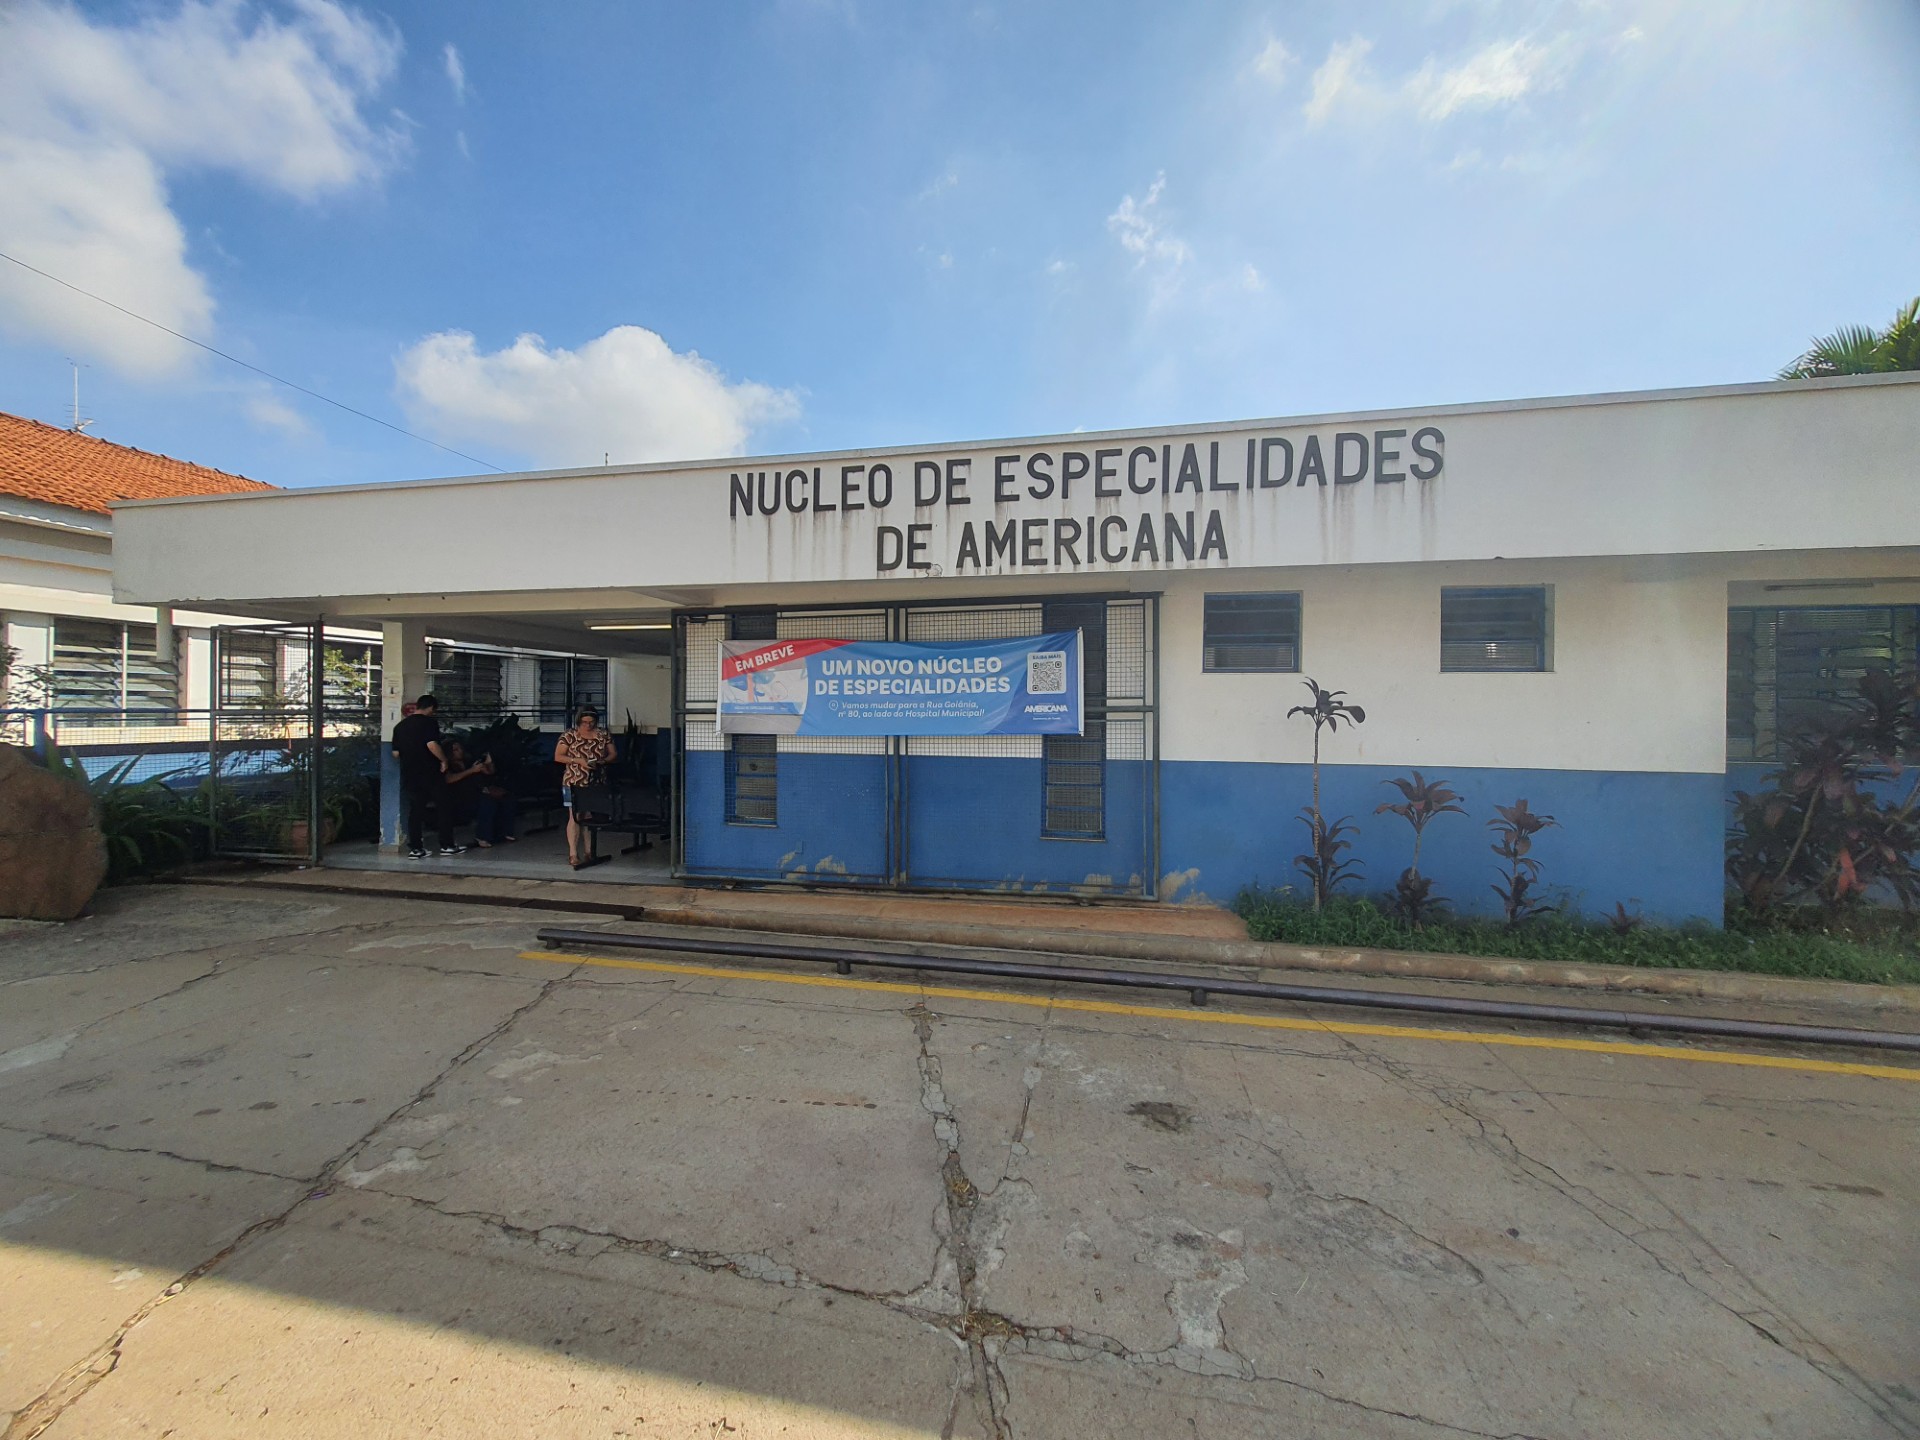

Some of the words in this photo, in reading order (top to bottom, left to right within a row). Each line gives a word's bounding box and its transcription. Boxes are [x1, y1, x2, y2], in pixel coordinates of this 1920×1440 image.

[730, 464, 893, 516] NUCLEO
[914, 459, 972, 507] DE
[994, 427, 1445, 502] ESPECIALIDADES
[876, 524, 933, 571] DE
[955, 509, 1229, 568] AMERICANA
[735, 658, 754, 672] EM
[755, 644, 795, 666] BREVE
[822, 659, 853, 676] UM
[857, 659, 914, 676] NOVO
[918, 655, 1002, 675] NÚCLEO
[815, 679, 839, 695] DE
[843, 676, 1011, 695] ESPECIALIDADES
[841, 701, 868, 709] Vamos
[870, 701, 897, 709] mudar
[898, 702, 918, 712] para
[926, 701, 943, 709] Rua
[847, 710, 861, 719] 80,
[874, 709, 892, 718] lado
[893, 709, 904, 718] do
[905, 708, 940, 718] Hospital
[1024, 704, 1069, 713] AMERICANA
